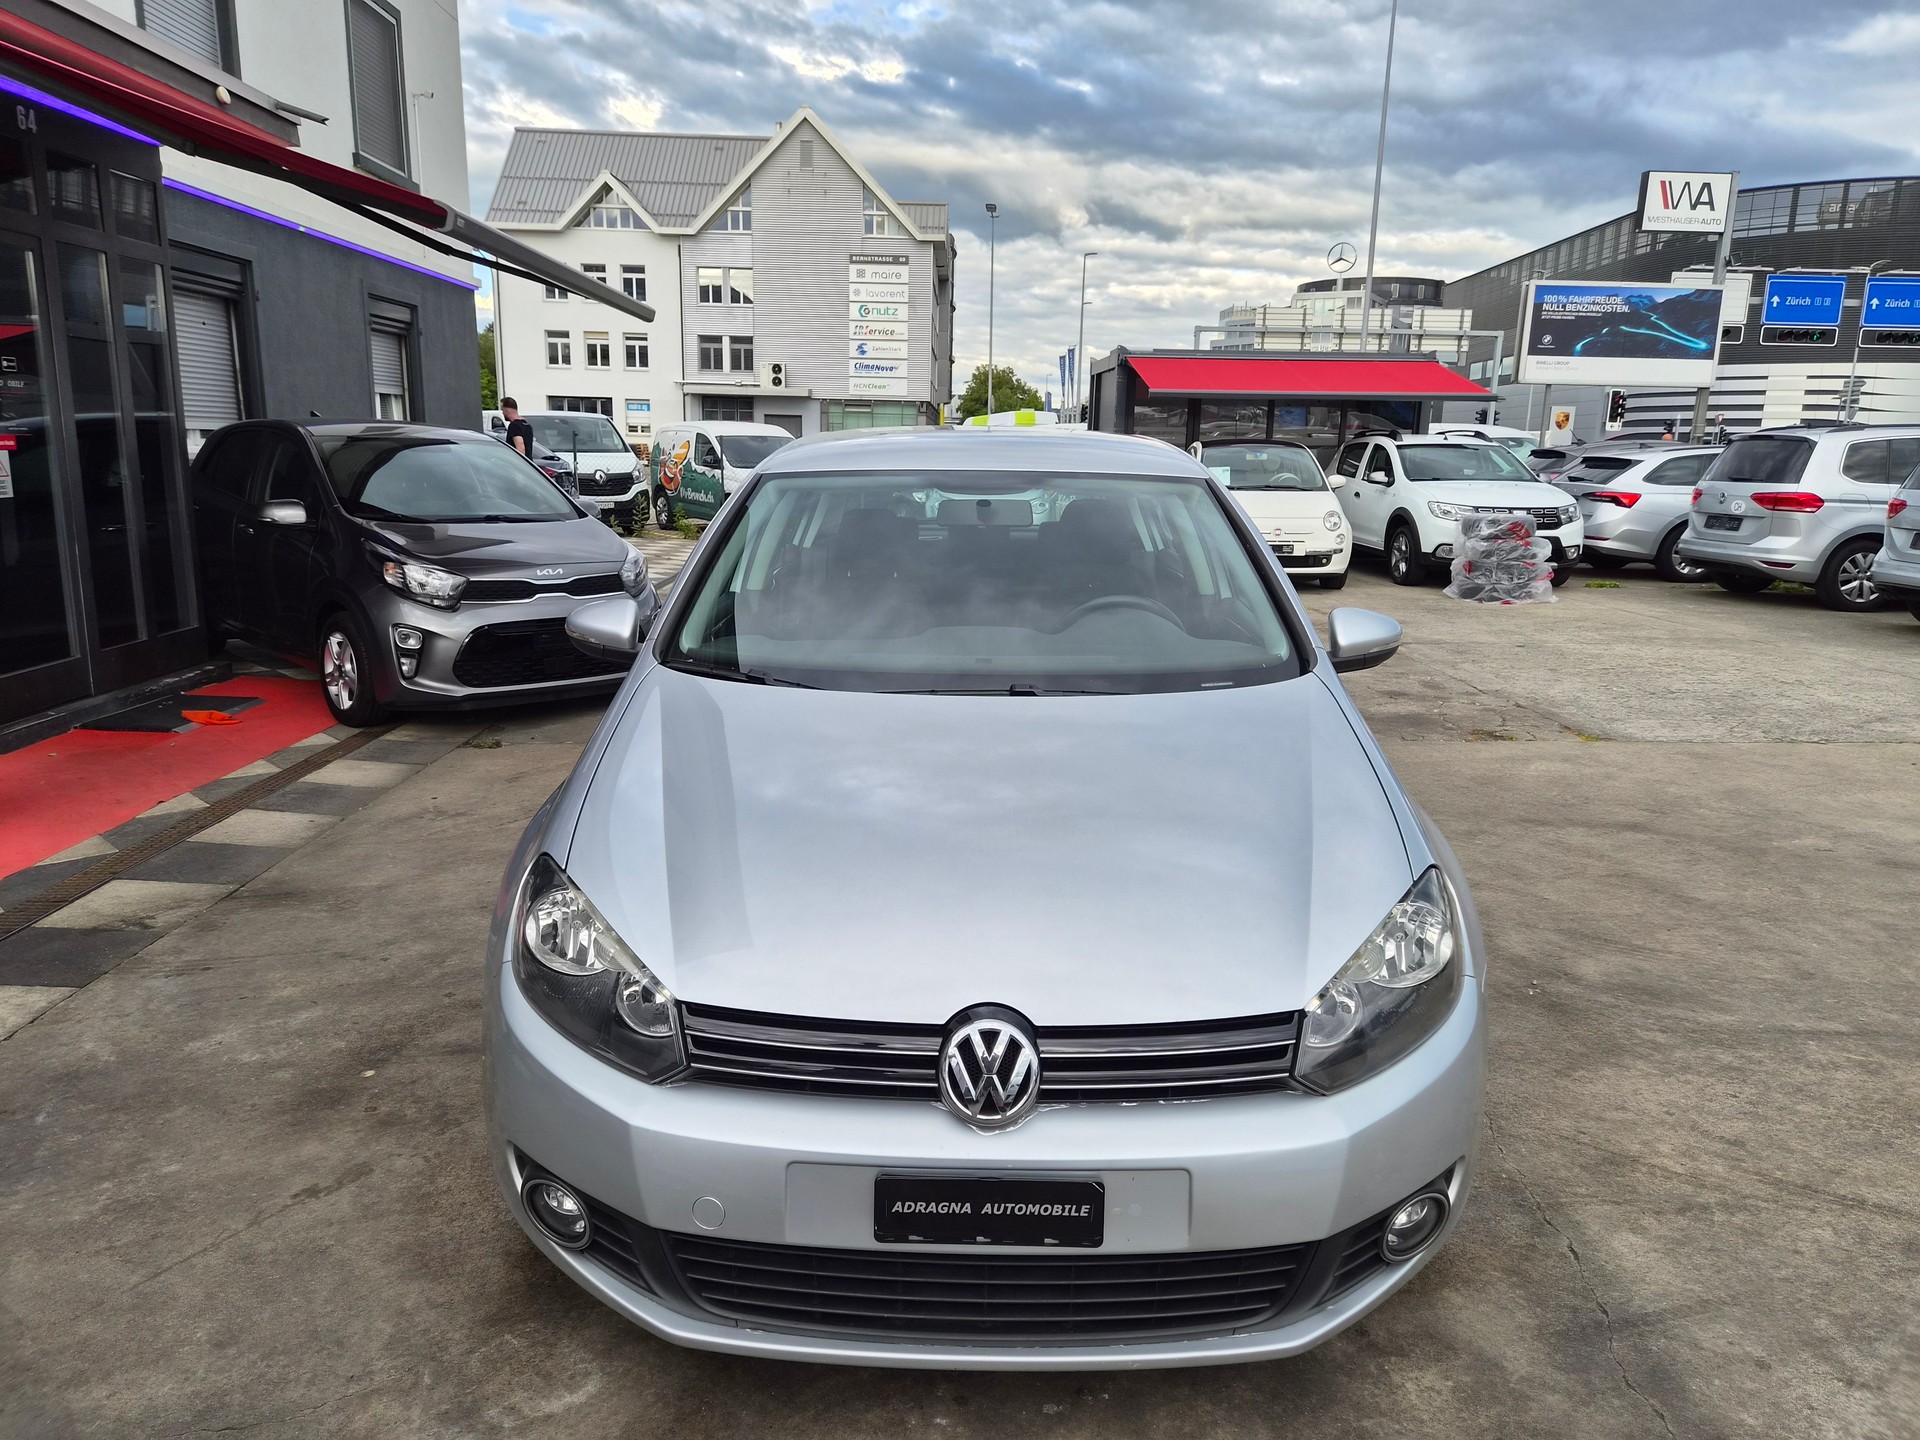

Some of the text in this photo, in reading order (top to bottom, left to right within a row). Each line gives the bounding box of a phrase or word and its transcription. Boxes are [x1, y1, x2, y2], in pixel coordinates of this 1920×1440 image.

[16, 105, 37, 134] 64
[871, 269, 902, 280] maire
[865, 288, 906, 299] lavorent
[1543, 295, 1558, 303] 100
[1568, 295, 1625, 304] FAHRFREUDE.
[1785, 296, 1811, 306] Zürich
[1885, 298, 1910, 308] Zürich
[871, 306, 898, 316] nutz
[1542, 303, 1631, 313] NULL BENZINKOSTEN.
[854, 362, 894, 371] ClimaNova
[1734, 502, 1743, 512] CH
[891, 1201, 1091, 1217] ADRAGNA AUTOMOBILE
